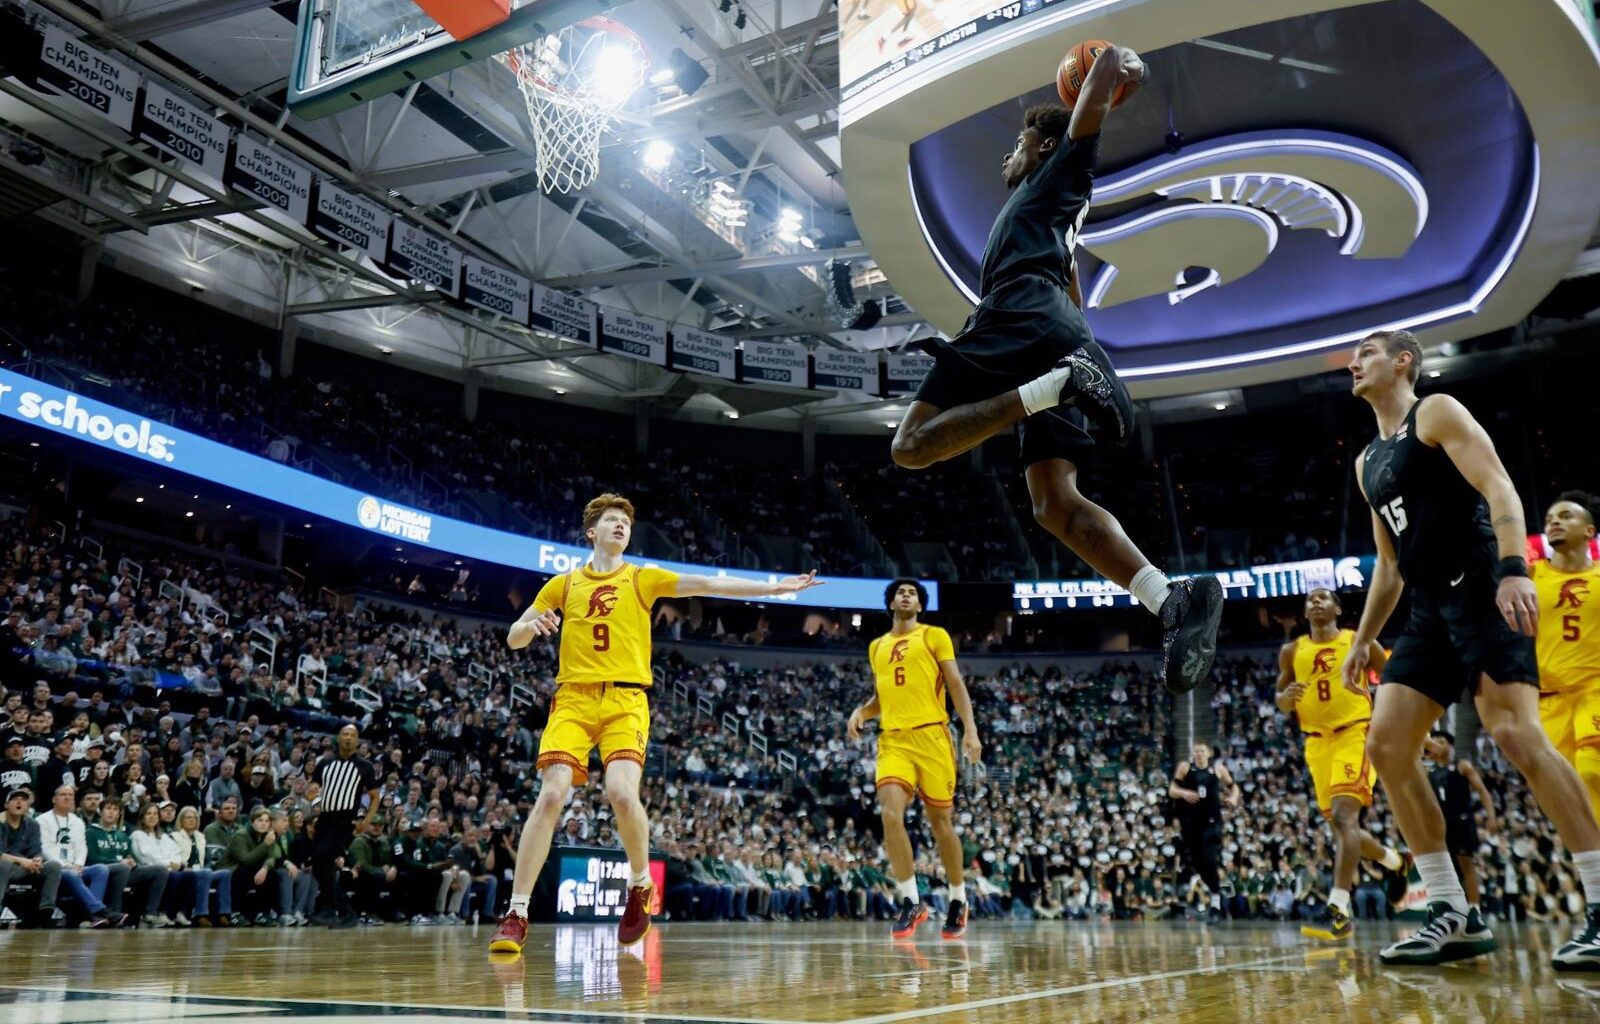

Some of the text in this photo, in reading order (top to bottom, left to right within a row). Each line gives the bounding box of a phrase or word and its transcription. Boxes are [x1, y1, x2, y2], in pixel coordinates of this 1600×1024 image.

[938, 22, 977, 49] AUSTIN
[65, 41, 119, 80] BIG TEN
[45, 46, 134, 102] CHAMPIONS
[68, 80, 106, 109] 2012
[165, 98, 212, 132] BIG TEN
[148, 104, 224, 153] CHAMPIONS
[168, 134, 200, 160] 2010
[254, 149, 296, 179] BIG TEN
[239, 155, 307, 199] CHAMPIONS
[254, 181, 287, 207] 2009
[321, 200, 385, 239] CHAMPIONS
[335, 194, 375, 221] BIG TEN
[337, 224, 367, 247] 2001
[401, 245, 453, 277] CHAMPIONS
[409, 261, 442, 286] 2000
[481, 266, 517, 287] BIG TEN
[469, 273, 527, 302] CHAMPIONS
[482, 293, 511, 312] 2000
[541, 306, 590, 329] CHAMPIONS
[551, 320, 578, 338] 1999
[616, 316, 654, 332] BIG TEN
[604, 324, 664, 345] CHAMPIONS
[687, 333, 722, 347] BIG TEN
[622, 341, 648, 355] 1999
[675, 341, 733, 360] CHAMPIONS
[757, 346, 794, 357] BIG TEN
[828, 353, 865, 365] BIG TEN
[692, 358, 718, 371] 1998
[745, 354, 805, 369] CHAMPIONS
[817, 361, 877, 376] CHAMPIONS
[762, 369, 789, 381] 1990
[834, 377, 860, 388] 1979
[382, 504, 431, 529] MICHIGAN
[1380, 496, 1408, 537] 15
[592, 623, 610, 652] 9
[1562, 615, 1581, 642] 5
[894, 666, 905, 687] 6
[1317, 679, 1331, 701] 8
